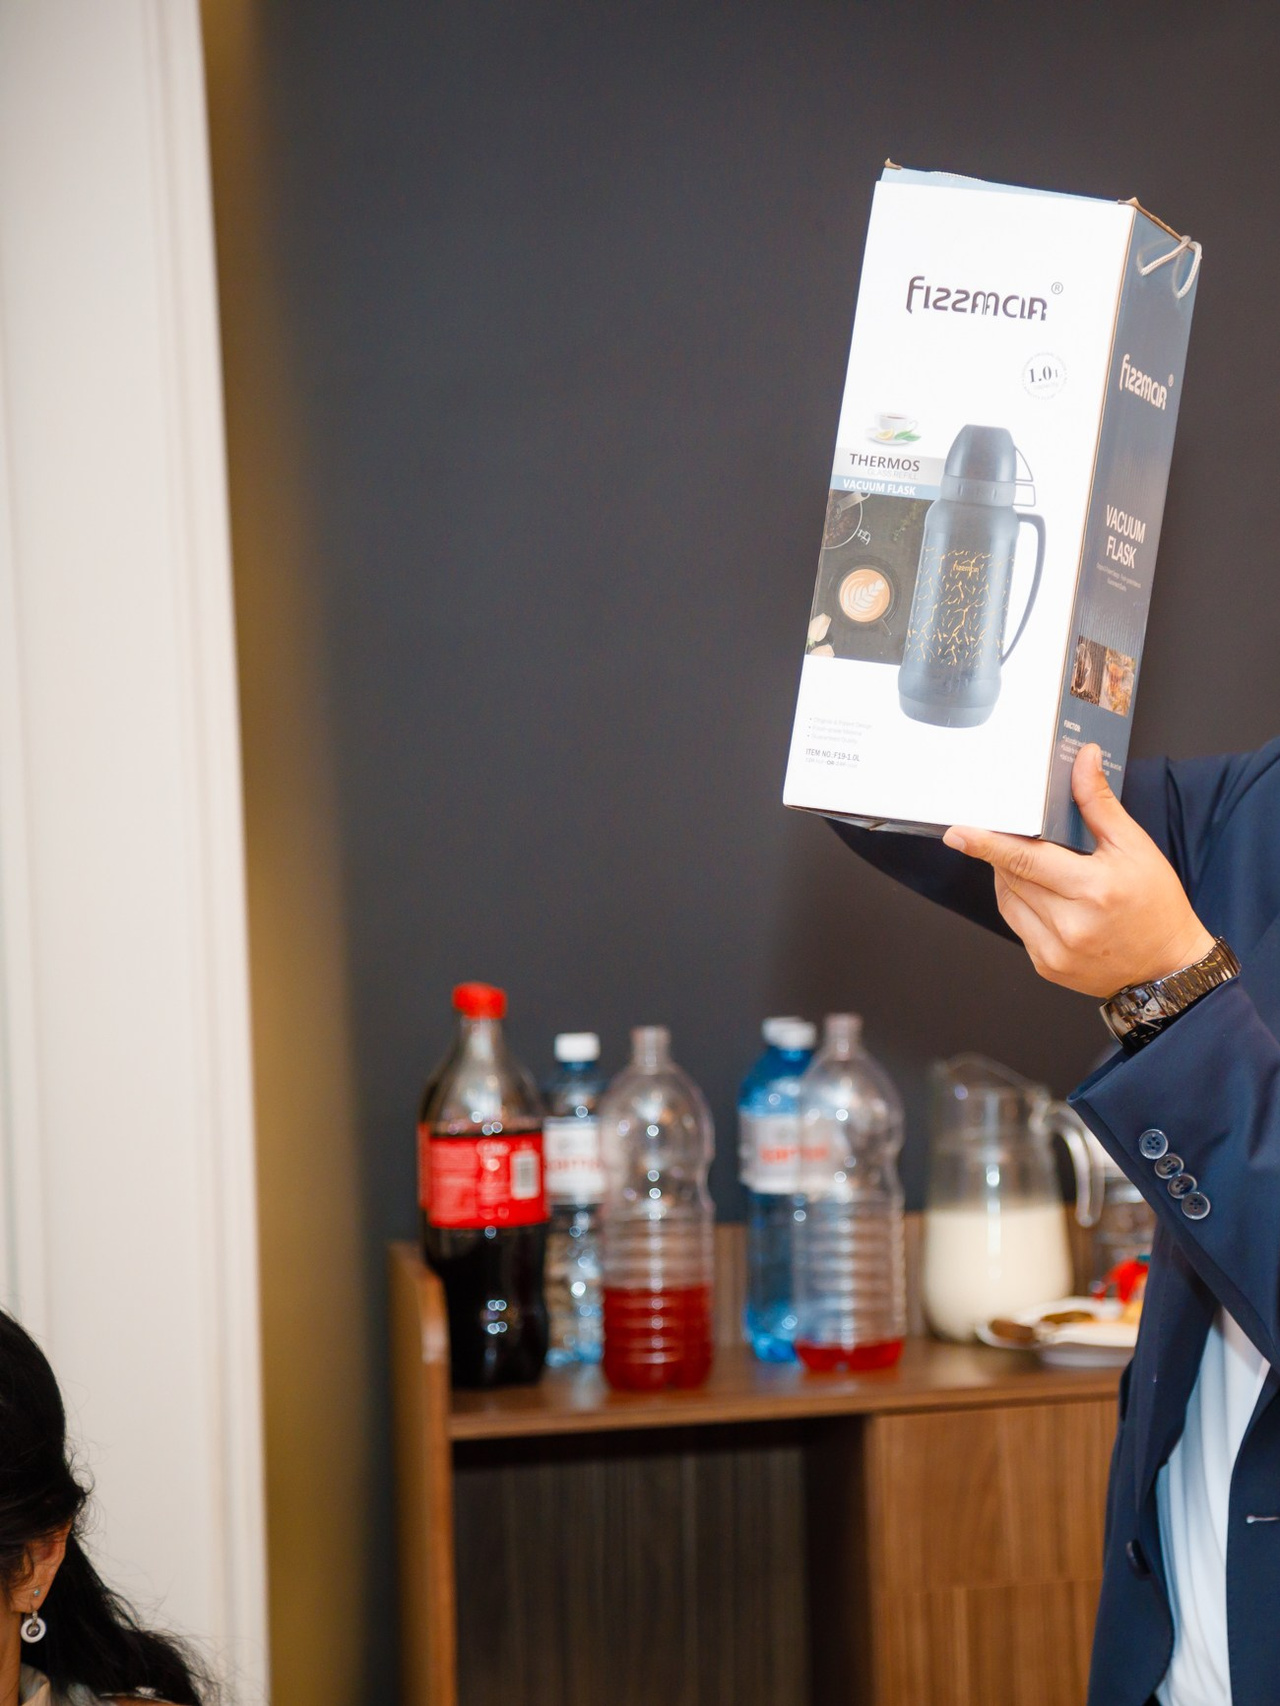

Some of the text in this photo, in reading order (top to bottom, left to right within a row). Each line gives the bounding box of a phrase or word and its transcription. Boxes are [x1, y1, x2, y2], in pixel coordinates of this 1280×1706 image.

[849, 453, 921, 472] THERMOS
[843, 479, 916, 496] VACUUM FLASK
[1106, 504, 1146, 544] VACUUM
[1106, 535, 1137, 569] FLASK
